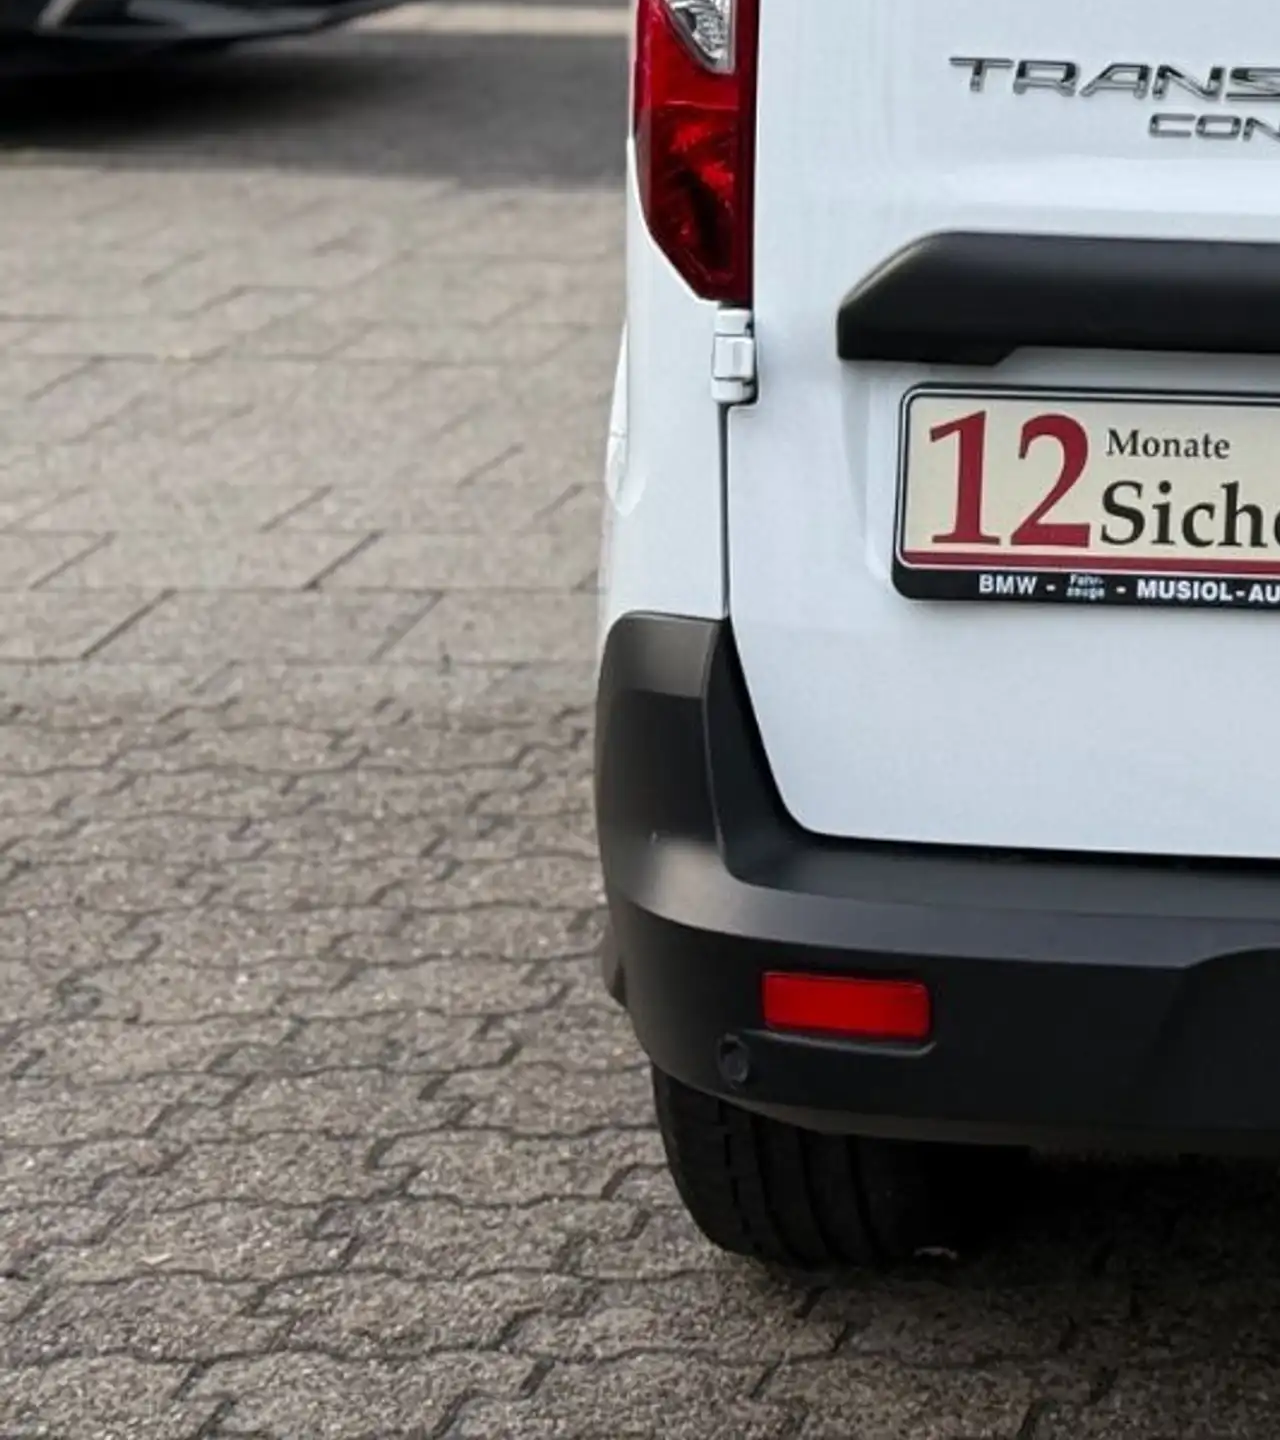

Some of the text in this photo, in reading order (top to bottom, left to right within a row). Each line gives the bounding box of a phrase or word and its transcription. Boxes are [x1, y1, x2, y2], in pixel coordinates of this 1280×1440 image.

[1106, 428, 1230, 459] Monate
[929, 410, 1091, 548] 12
[978, 574, 1038, 596] BMW
